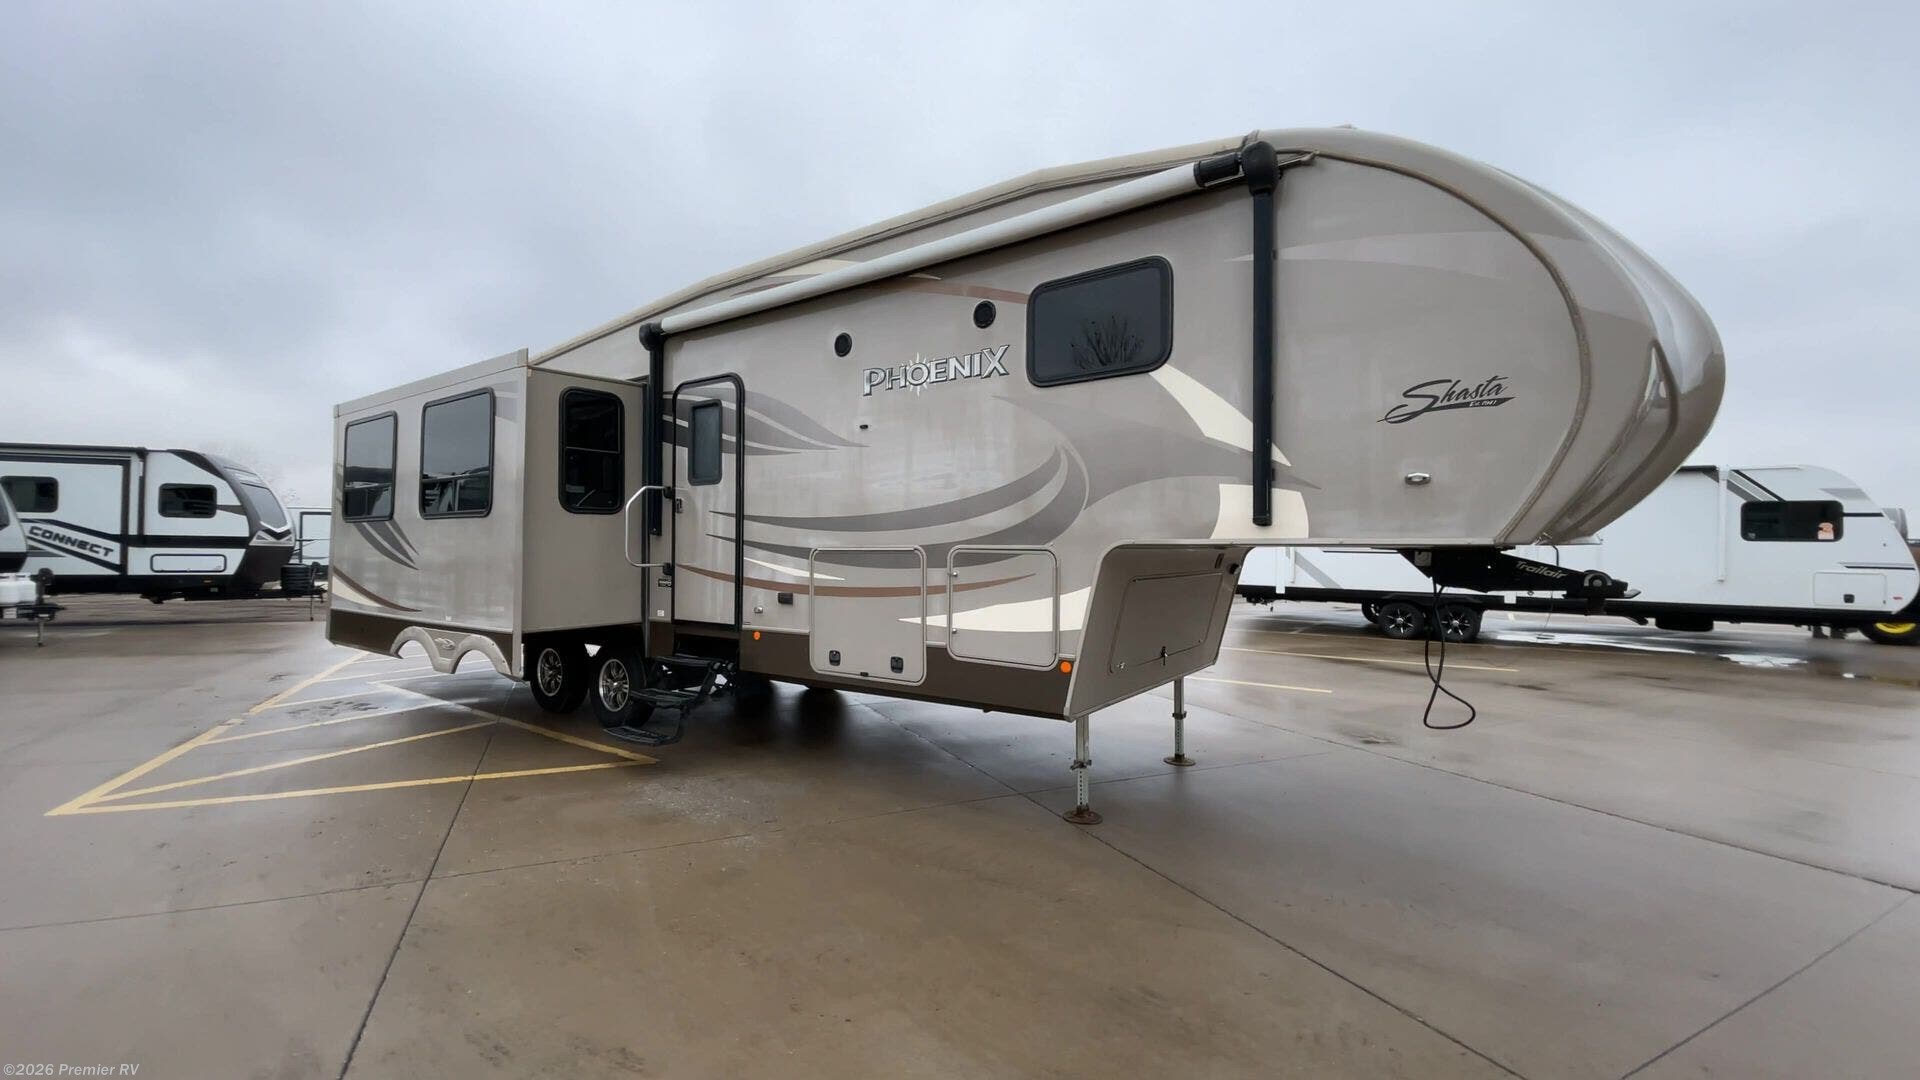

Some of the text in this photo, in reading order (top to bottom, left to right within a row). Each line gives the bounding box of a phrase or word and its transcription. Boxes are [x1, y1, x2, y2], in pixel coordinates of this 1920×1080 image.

[862, 344, 1010, 397] PHOENIX
[1384, 375, 1509, 424] Shasta
[29, 526, 114, 557] CONNECT
[1515, 560, 1567, 579] Trailair
